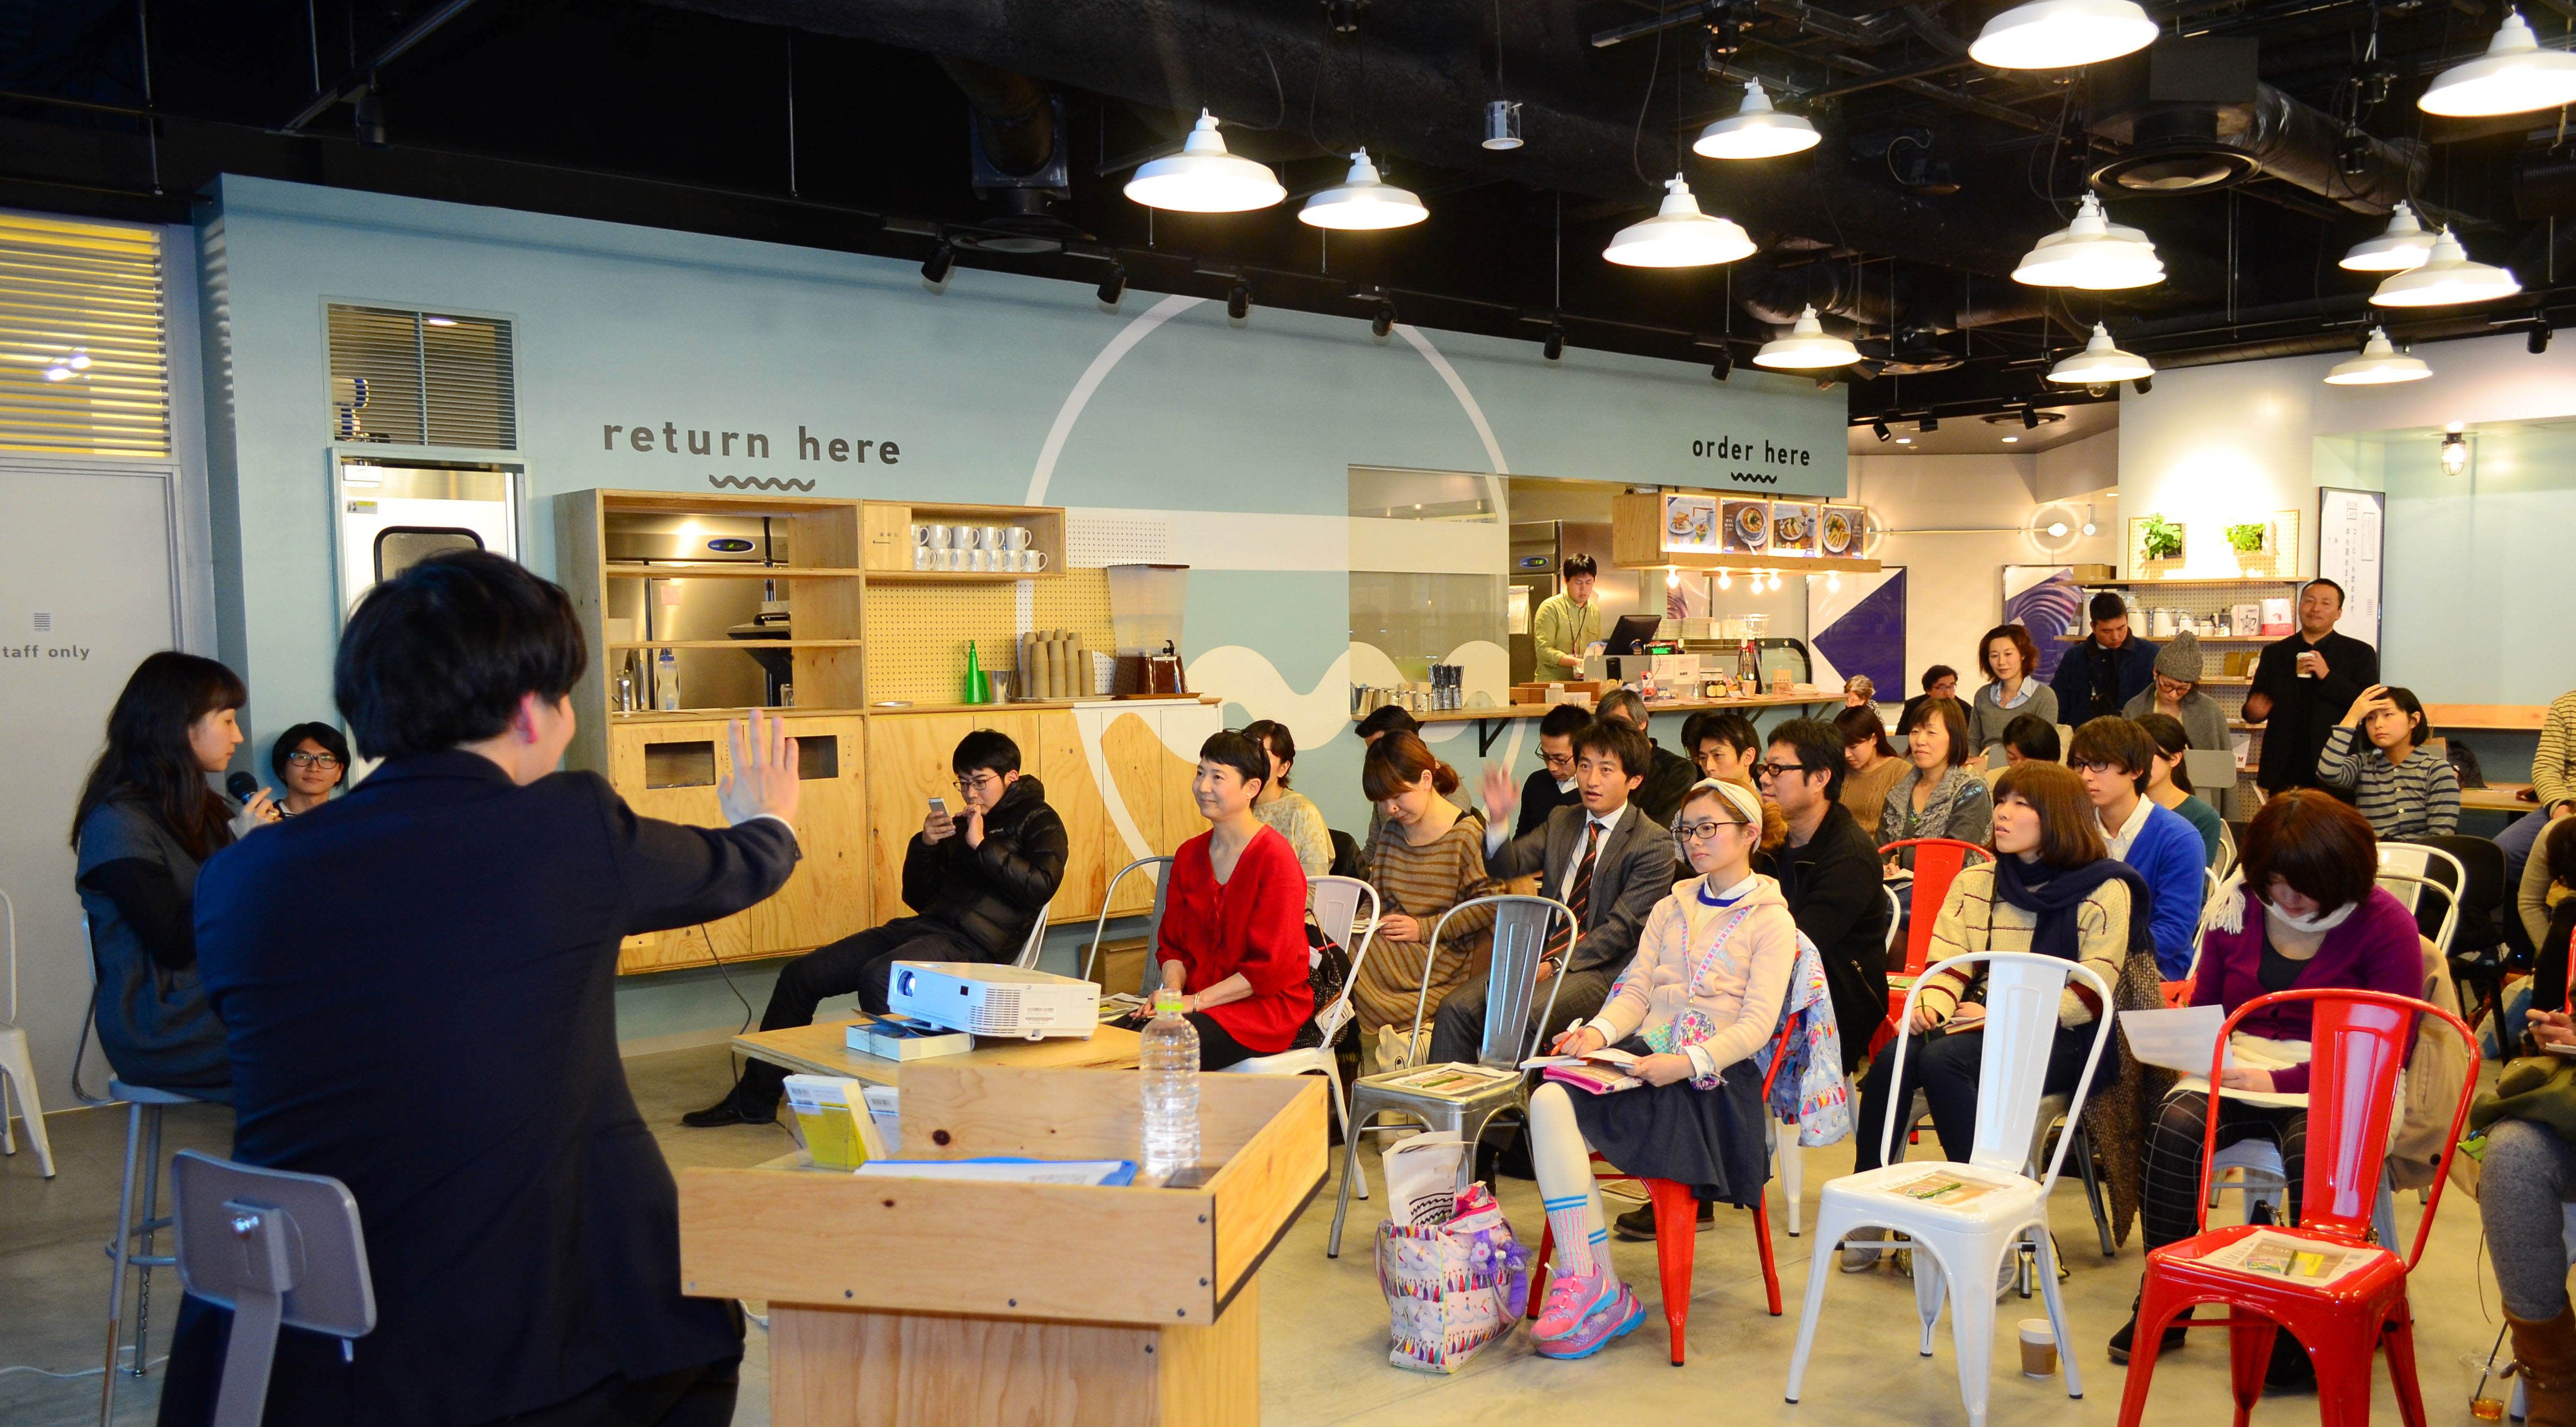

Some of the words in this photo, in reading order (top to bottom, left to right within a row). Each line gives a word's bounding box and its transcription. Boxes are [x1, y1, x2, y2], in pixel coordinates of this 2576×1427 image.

[604, 422, 769, 458] return
[799, 425, 900, 464] here
[1693, 435, 1753, 461] order
[1765, 439, 1809, 466] here
[2, 645, 39, 658] taff
[48, 645, 90, 660] only
